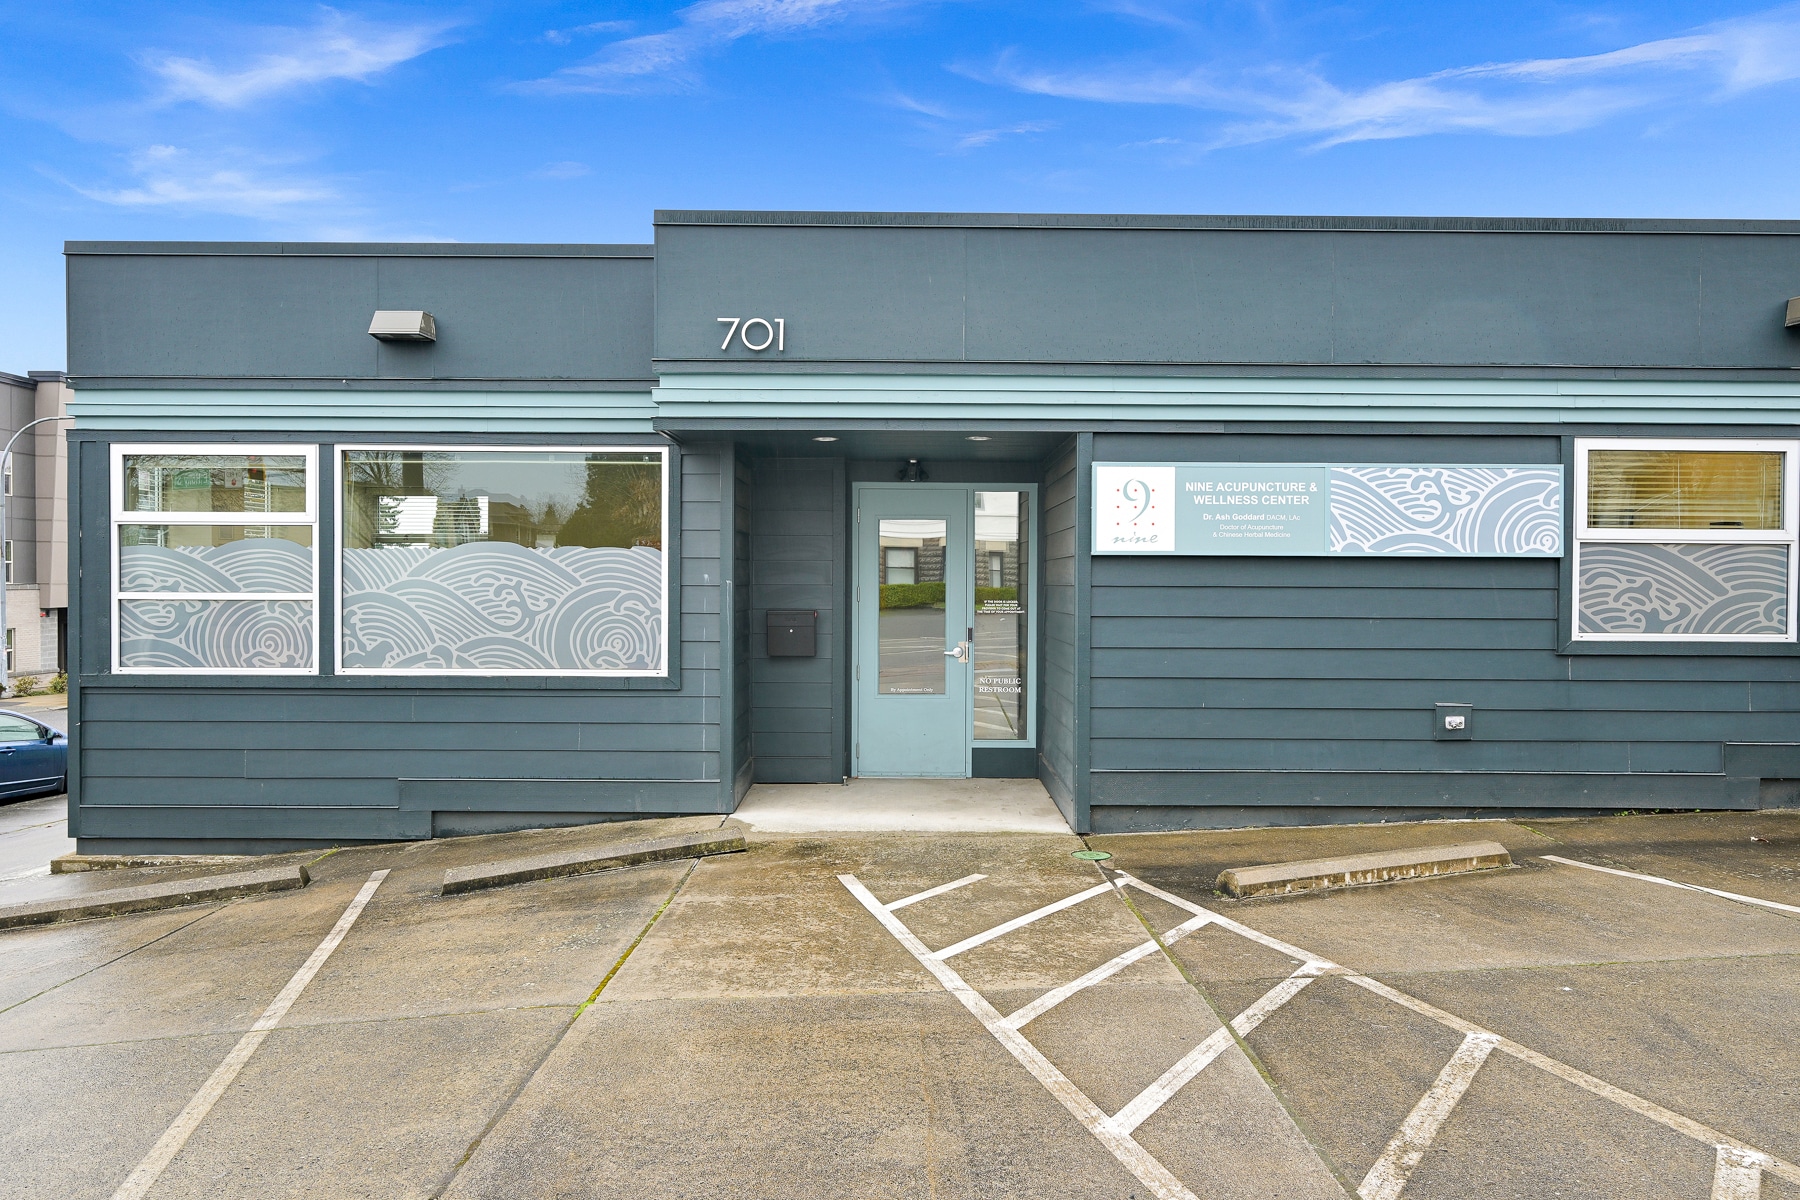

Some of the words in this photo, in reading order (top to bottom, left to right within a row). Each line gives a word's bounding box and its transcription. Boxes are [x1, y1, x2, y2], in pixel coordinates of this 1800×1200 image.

[717, 317, 784, 351] 701
[1185, 482, 1213, 492] NINE
[1216, 482, 1306, 492] ACUPUNCTURE
[1309, 482, 1318, 492] &
[1122, 478, 1151, 523] 9
[1193, 495, 1259, 505] WELLNESS
[1261, 495, 1310, 505] CENTER
[1203, 513, 1214, 521] Dr.
[1215, 513, 1230, 521] Ash
[1232, 513, 1265, 521] Goddard
[1112, 531, 1159, 544] nine
[979, 677, 992, 685] NO
[993, 677, 1022, 685] PUBLIC
